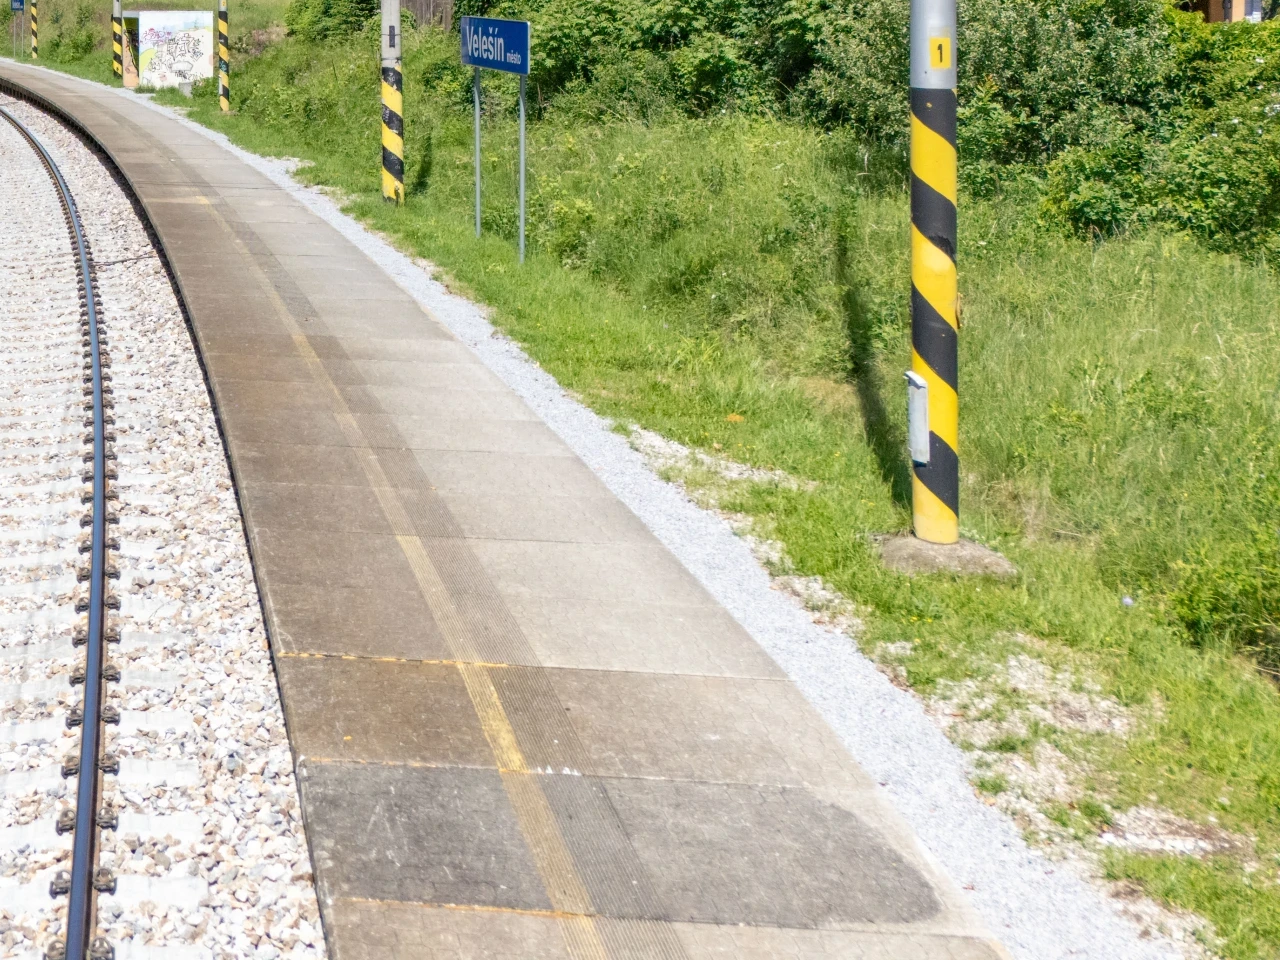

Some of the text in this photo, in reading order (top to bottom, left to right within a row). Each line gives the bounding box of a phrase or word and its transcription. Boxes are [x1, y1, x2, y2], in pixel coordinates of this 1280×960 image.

[466, 26, 522, 65] Velešín město
[937, 43, 943, 63] 1
